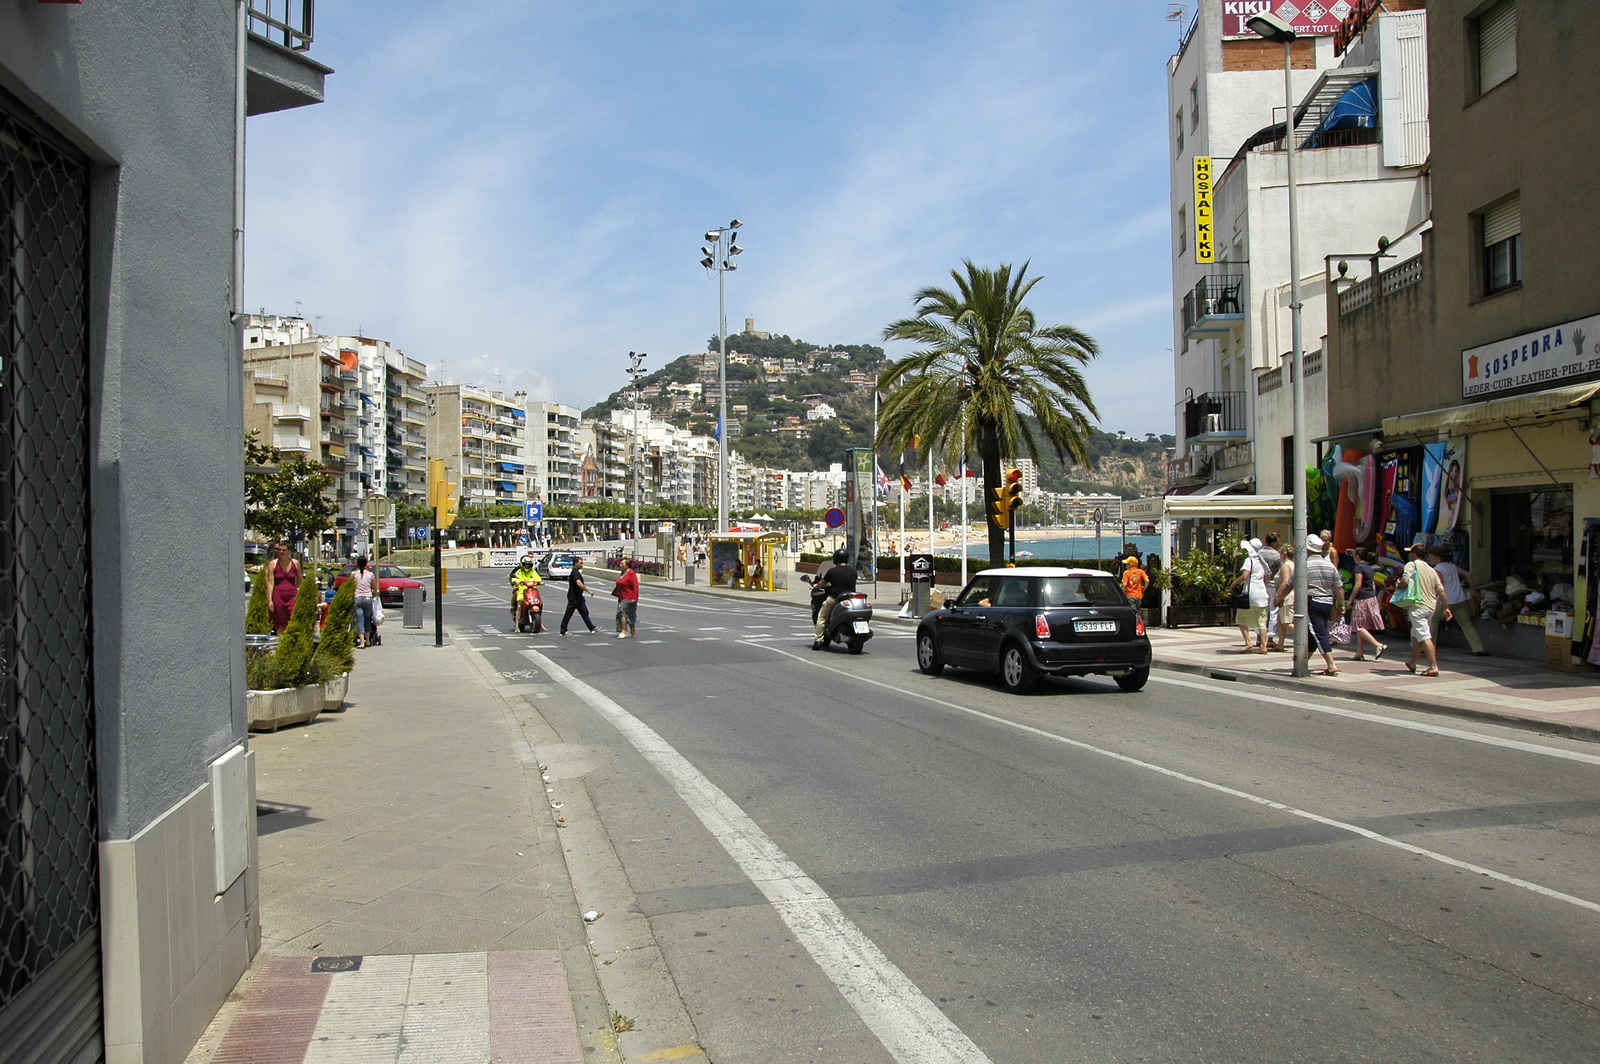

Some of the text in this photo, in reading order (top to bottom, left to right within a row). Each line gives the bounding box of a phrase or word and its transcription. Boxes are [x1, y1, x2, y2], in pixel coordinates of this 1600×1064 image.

[1225, 1, 1271, 14] KIKU
[1312, 25, 1328, 33] TOT
[1197, 163, 1211, 259] HOSTAL KIKU
[1485, 328, 1563, 379] SOSPEDRA
[1464, 382, 1490, 396] LEDER
[1491, 377, 1513, 390] CUIR
[1515, 367, 1559, 385] LEATHER
[1561, 360, 1585, 376] PIEL
[530, 507, 539, 517] P
